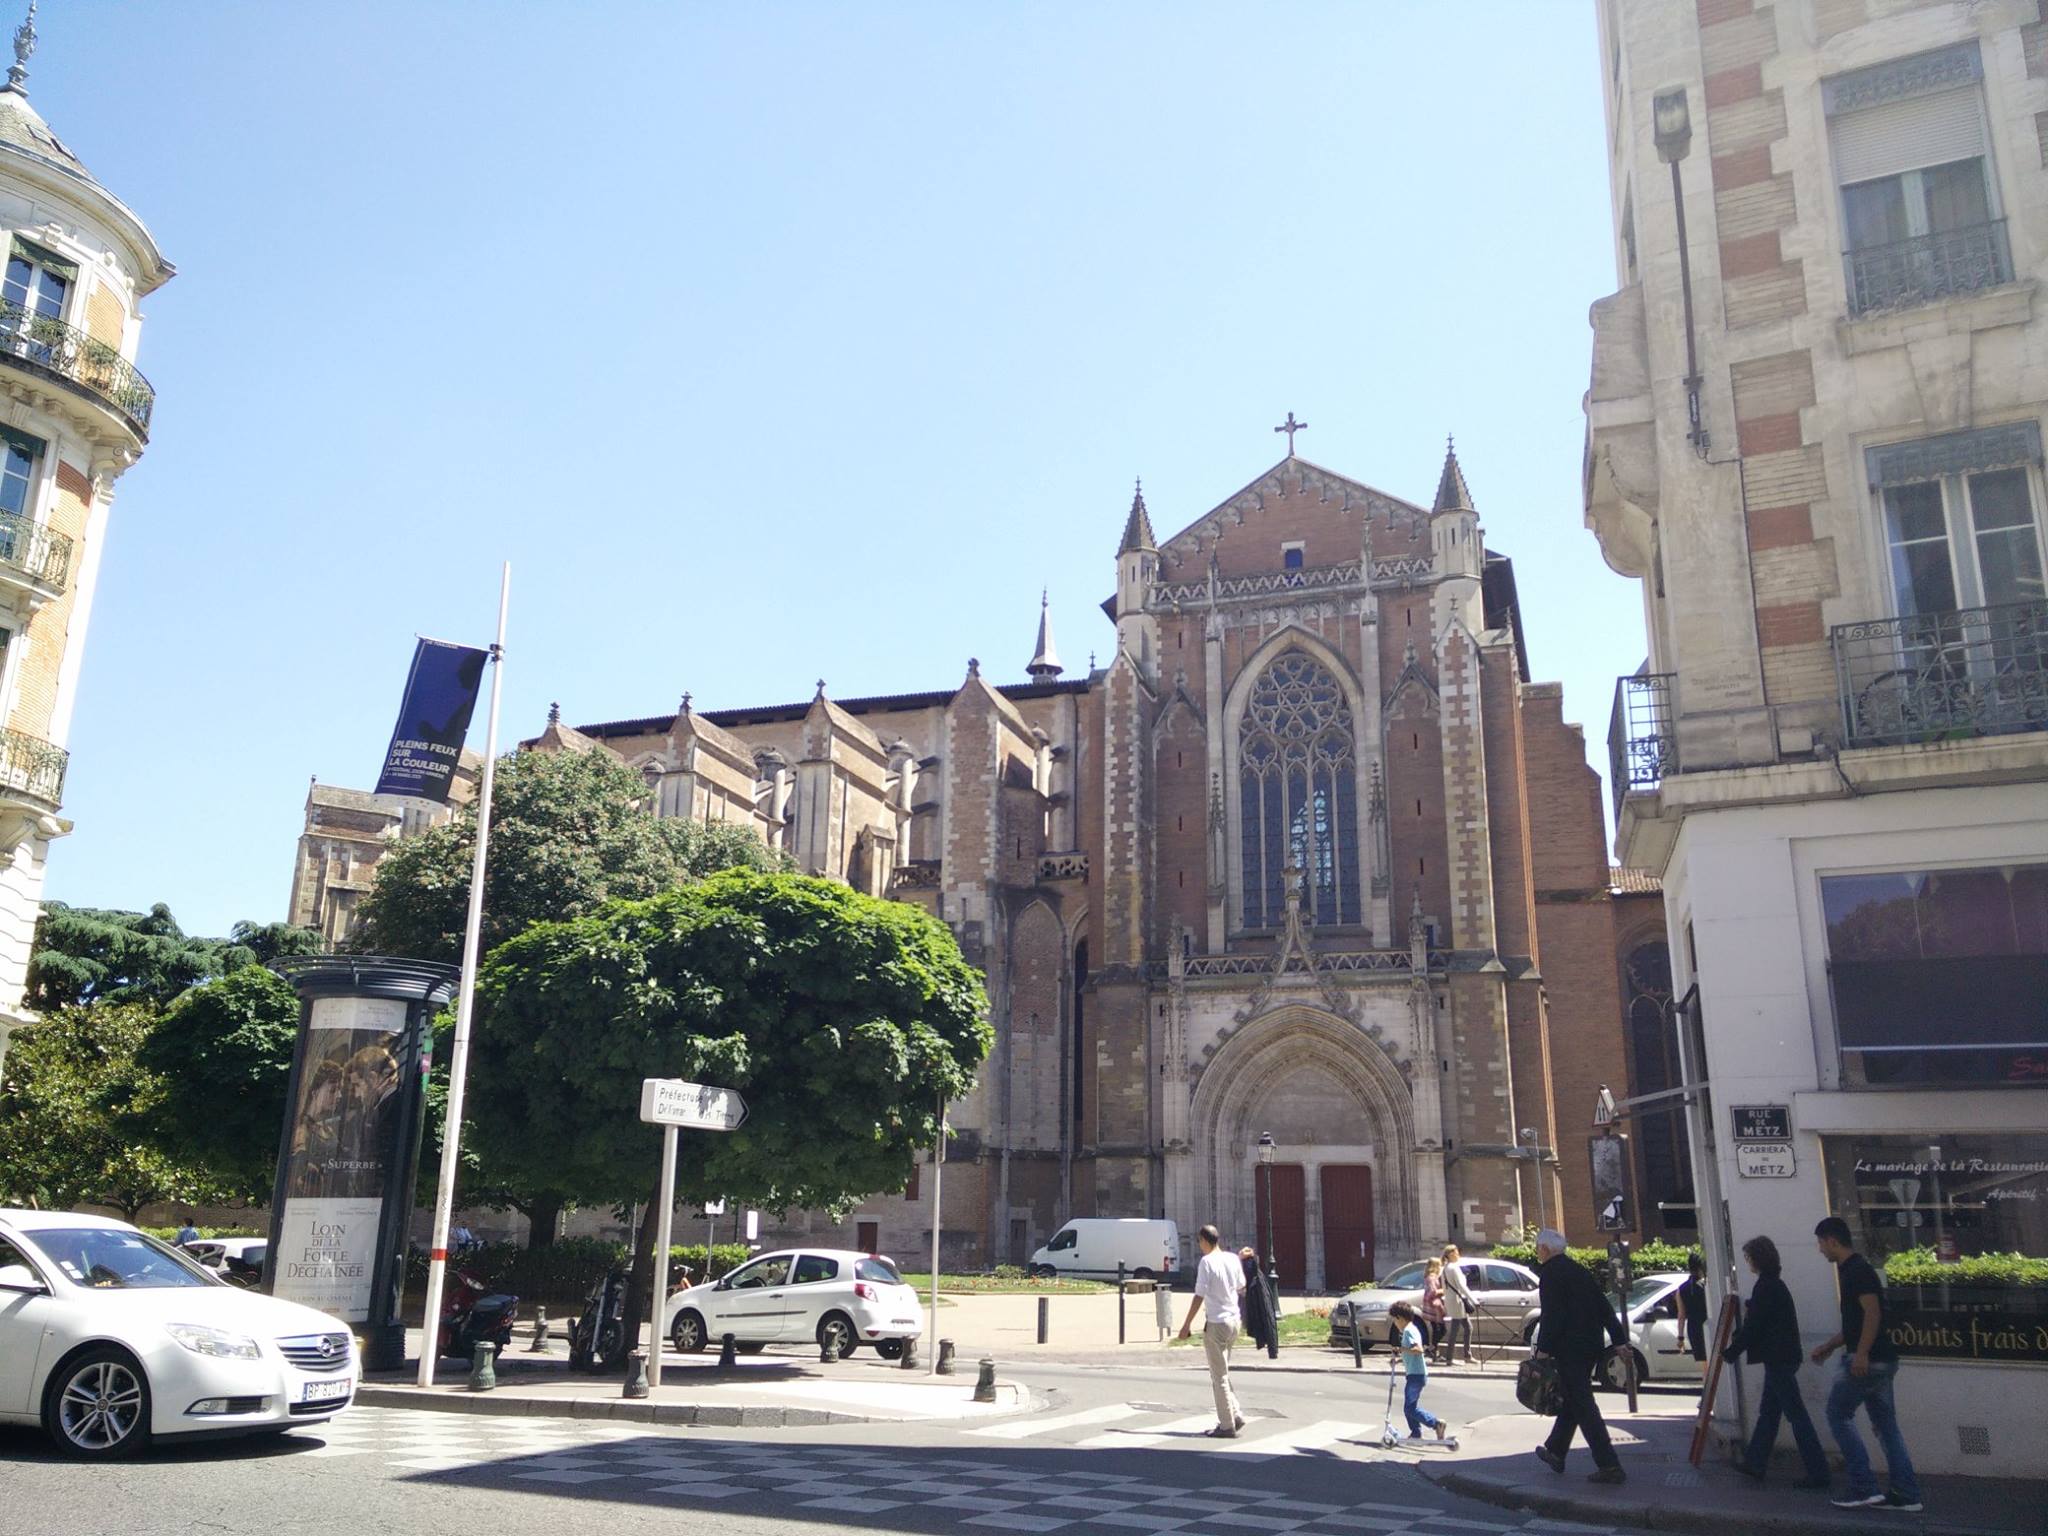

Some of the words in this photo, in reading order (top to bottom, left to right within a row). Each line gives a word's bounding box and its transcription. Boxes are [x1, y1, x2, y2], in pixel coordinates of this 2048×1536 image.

[392, 749, 412, 758] SUR
[395, 740, 429, 751] PLEINS
[429, 743, 458, 757] FEUX
[389, 758, 400, 766] LA
[402, 758, 450, 774] COULEUR
[1748, 1110, 1772, 1119] RUE
[1743, 1126, 1780, 1136] METZ
[1749, 1165, 1785, 1175] METZ
[1855, 1159, 1872, 1172] Le
[1875, 1161, 1929, 1175] mariage
[1932, 1160, 1947, 1172] de
[329, 1239, 341, 1247] LA
[1886, 1321, 1963, 1349] oduits
[1970, 1316, 2029, 1359] frais
